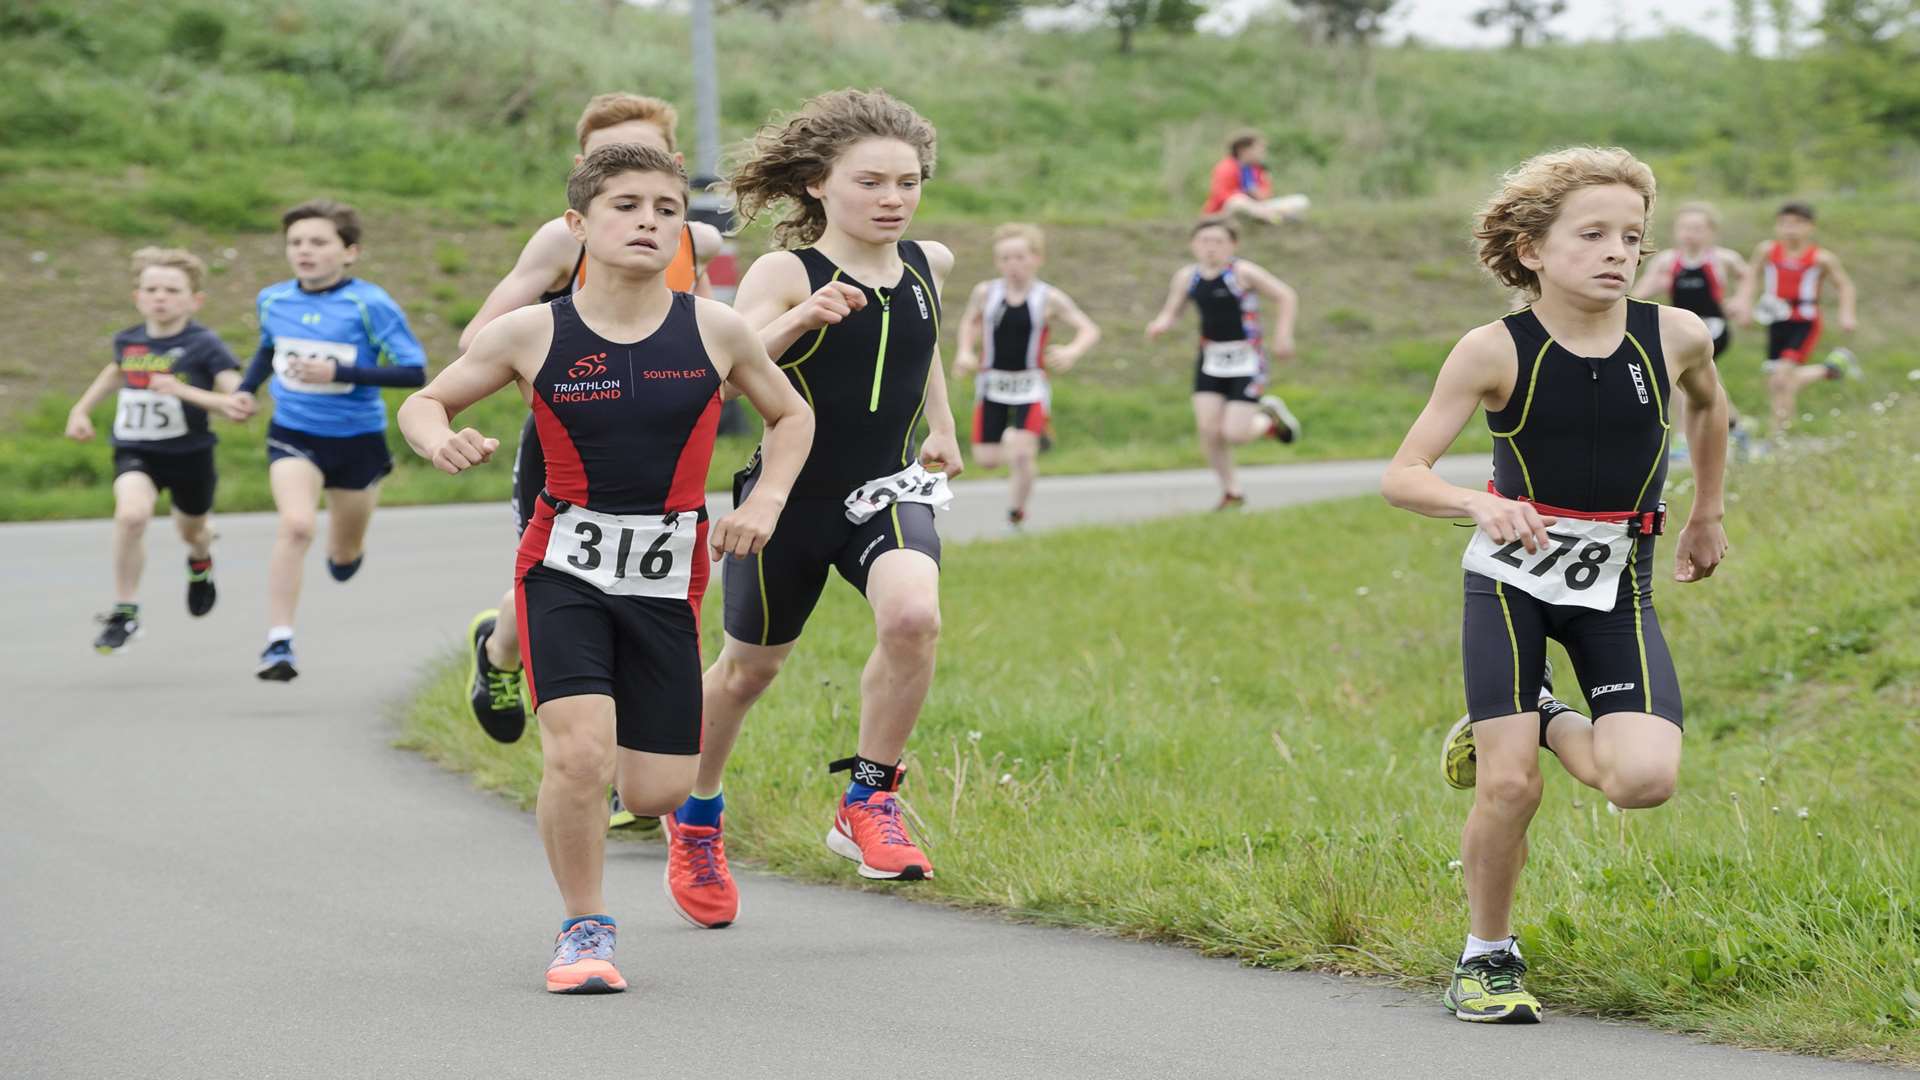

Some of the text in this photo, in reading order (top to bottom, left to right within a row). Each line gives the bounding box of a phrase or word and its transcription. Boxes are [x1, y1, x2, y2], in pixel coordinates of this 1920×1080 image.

[643, 368, 706, 379] SOUTH EAST
[553, 379, 620, 393] TRIATHLON
[1628, 363, 1648, 404] ZONE3
[552, 389, 621, 403] ENGLAND
[567, 521, 673, 580] 316
